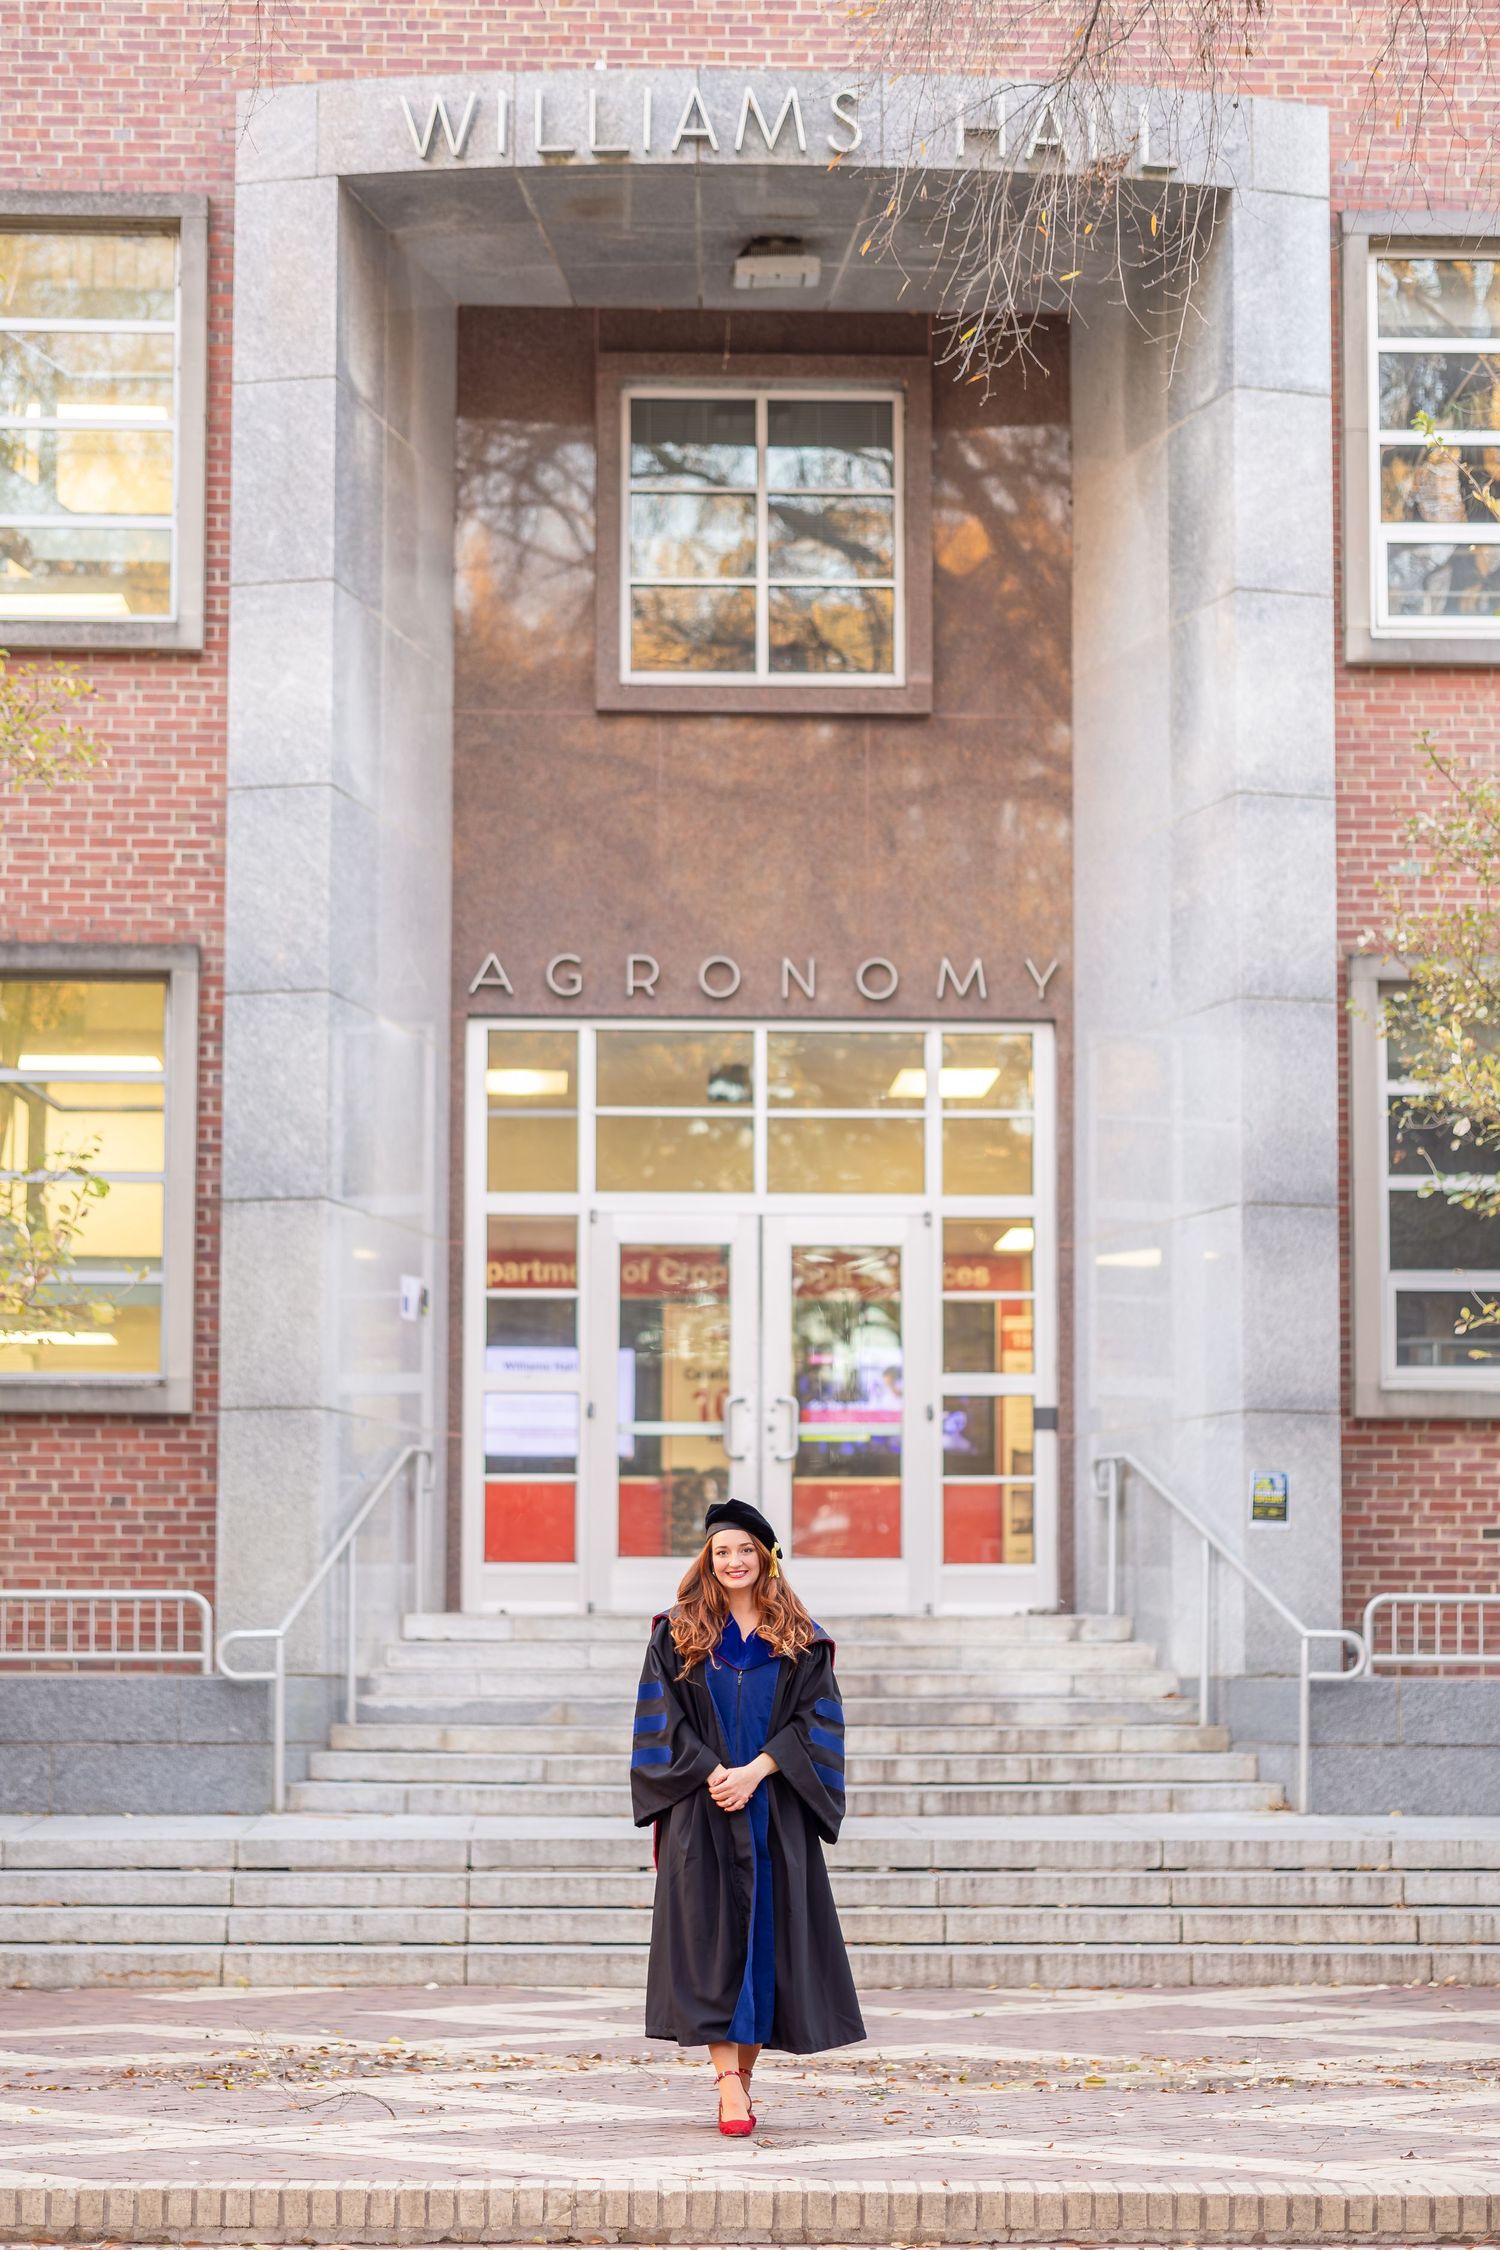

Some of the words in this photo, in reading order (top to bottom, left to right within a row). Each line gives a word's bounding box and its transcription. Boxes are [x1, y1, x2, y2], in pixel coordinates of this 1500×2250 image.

[400, 86, 864, 159] WILLIAMS
[956, 92, 1178, 169] HALL
[468, 952, 1059, 1000] AGRONOMY
[622, 1258, 651, 1284] of
